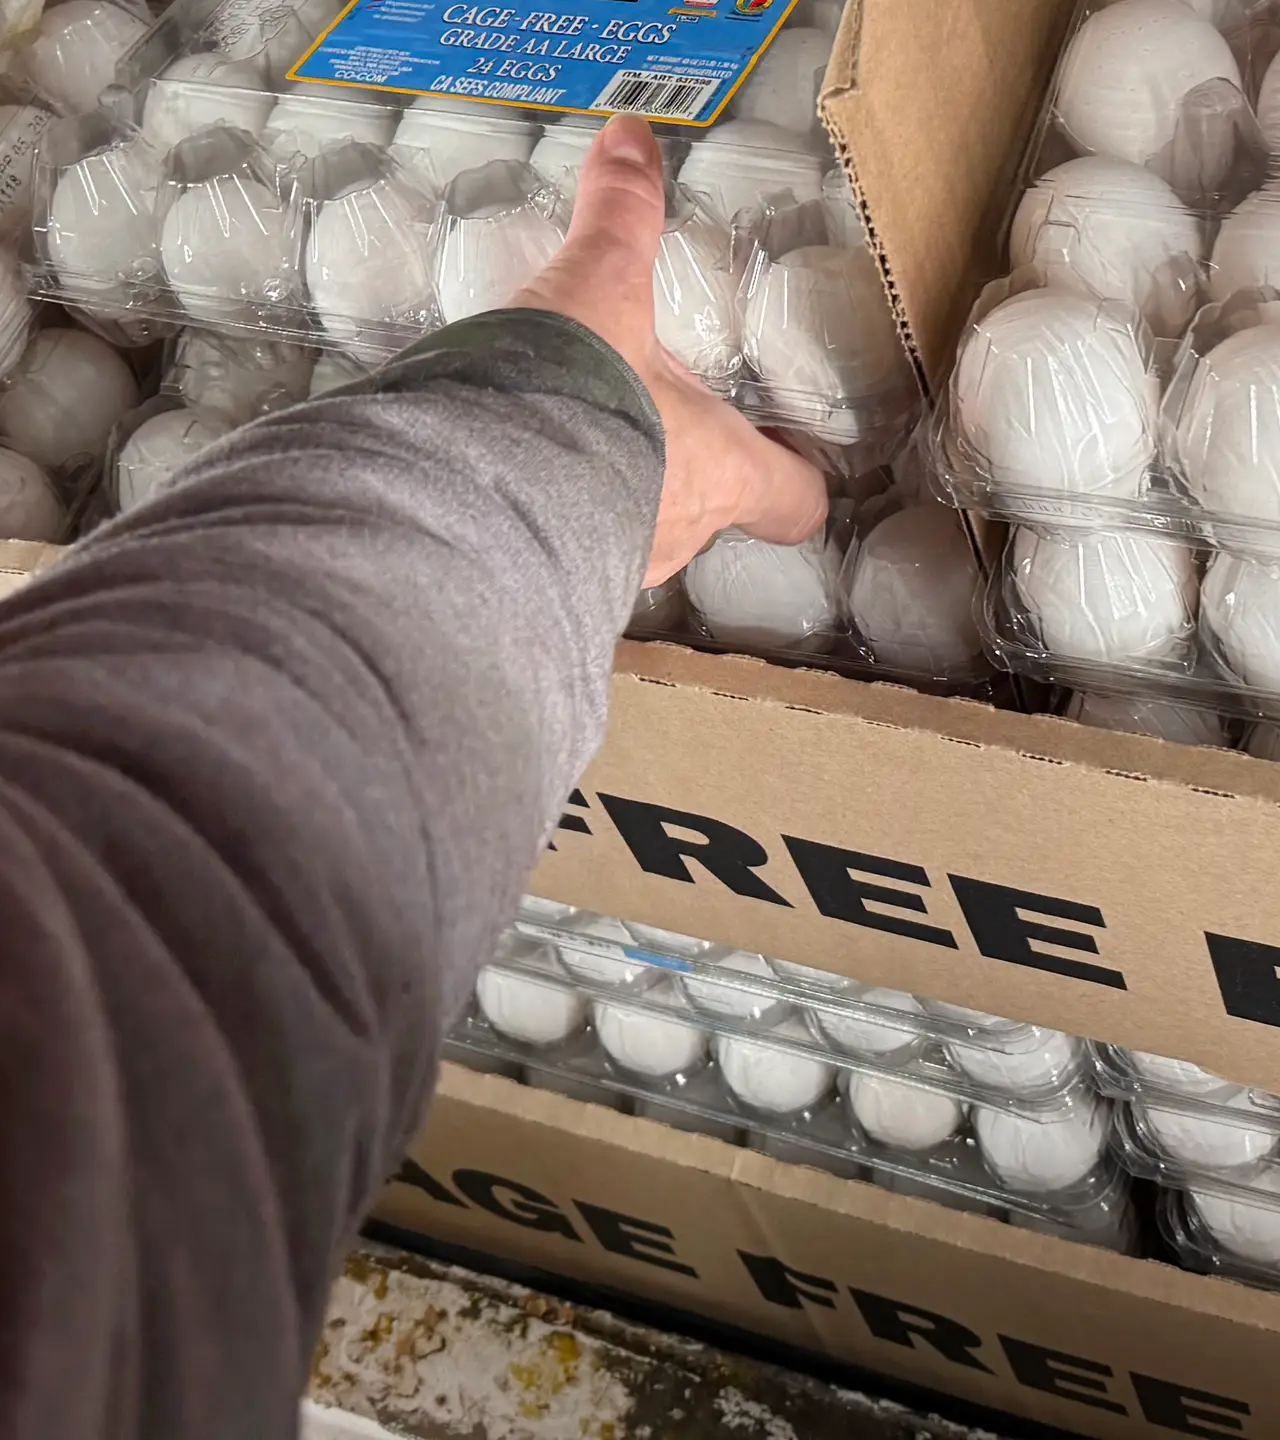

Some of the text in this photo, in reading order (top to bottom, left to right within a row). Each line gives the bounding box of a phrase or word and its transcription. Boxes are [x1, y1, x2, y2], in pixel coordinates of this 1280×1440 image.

[442, 3, 588, 35] CAGE-FREE
[600, 20, 676, 44] EGGS
[440, 28, 520, 53] GRADE
[523, 38, 552, 55] AA
[552, 41, 632, 65] LARGE
[335, 71, 387, 82] CO-COM
[467, 57, 562, 82] 24 EGGS
[431, 75, 566, 104] CA SEFS COMPLIANT
[735, 1248, 1262, 1440] FREE
